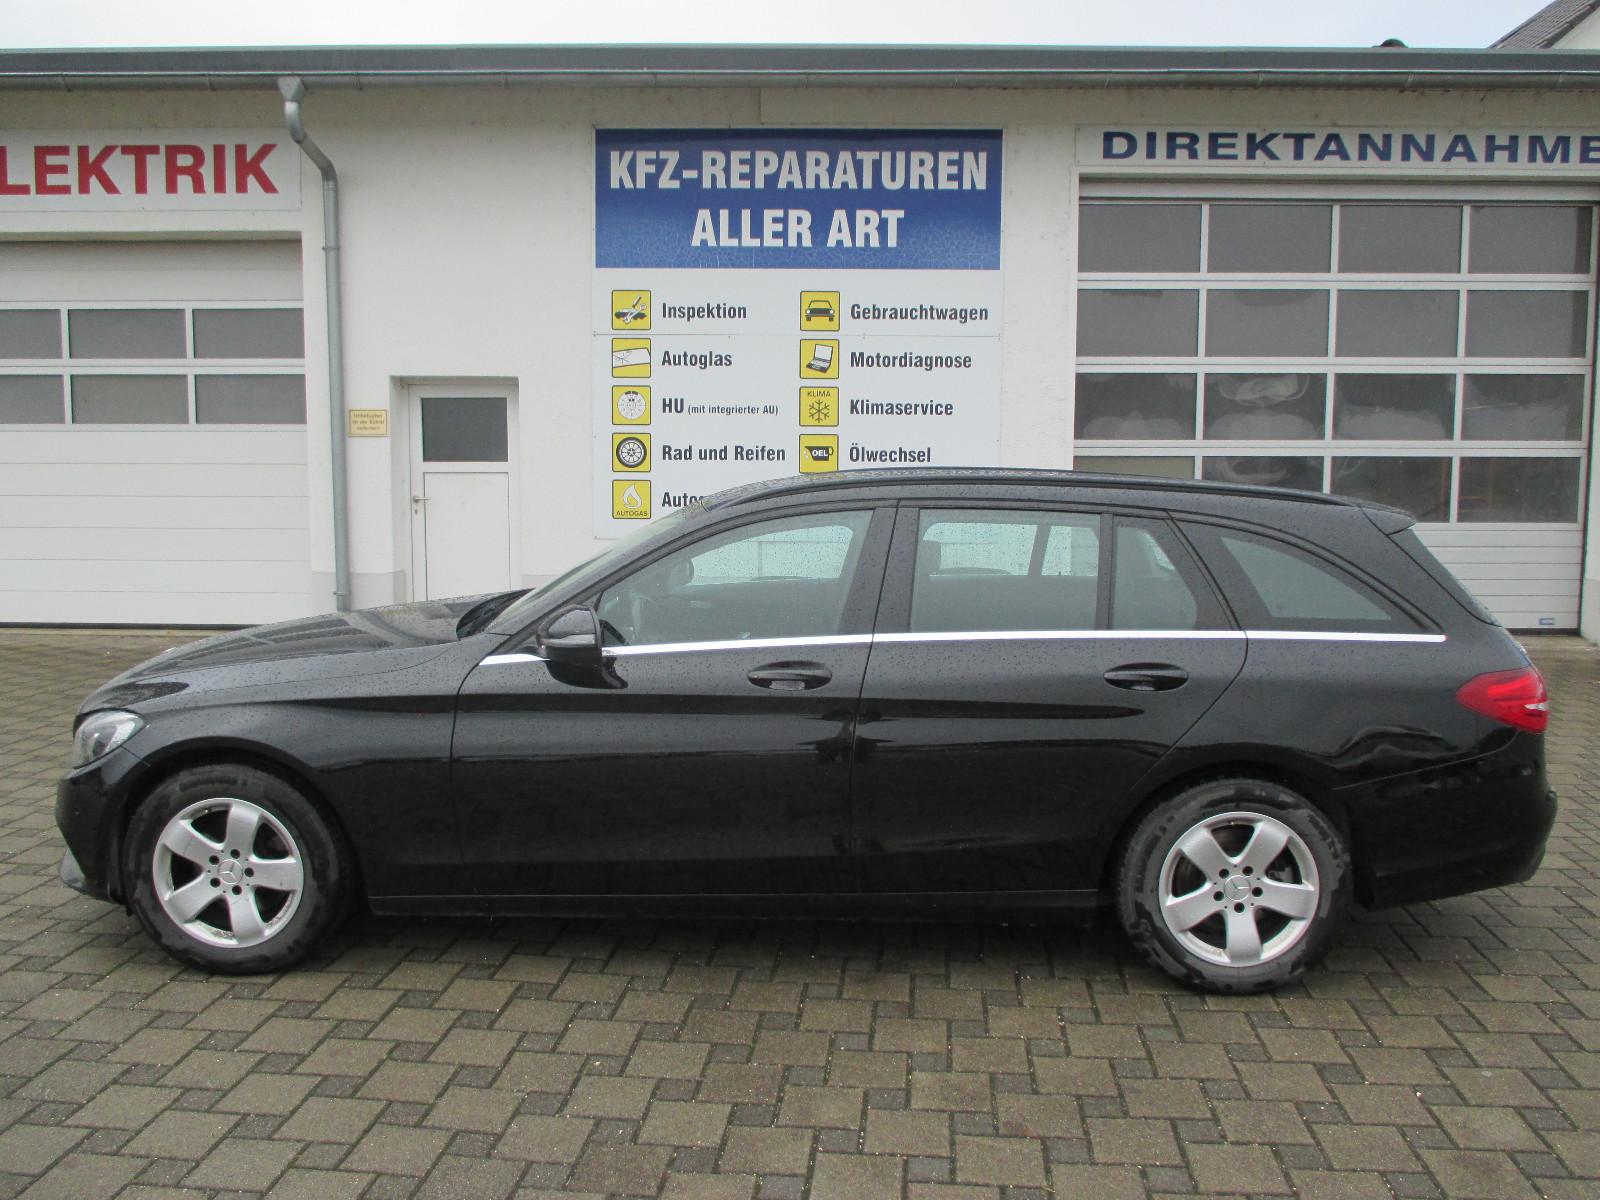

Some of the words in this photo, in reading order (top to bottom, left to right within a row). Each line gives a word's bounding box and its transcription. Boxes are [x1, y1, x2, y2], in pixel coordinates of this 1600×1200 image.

[1102, 131, 1600, 164] DIREKTANNAHME
[0, 143, 280, 195] LEKTRIK
[610, 150, 988, 191] KFZ-REPARATUREN
[690, 208, 813, 248] ALLER
[826, 208, 905, 248] ART
[662, 302, 747, 322] Inspektion
[850, 303, 989, 324] Gebrauchtwagen
[661, 350, 733, 370] Autoglas
[850, 351, 972, 371] Motordiagnose
[807, 390, 831, 398] KLIMA
[662, 397, 685, 414] HU
[688, 405, 706, 416] (mit
[708, 404, 760, 416] integrierter
[763, 405, 779, 416] AU)
[850, 399, 954, 416] Klimaservice
[662, 444, 693, 461] Rad
[699, 445, 728, 461] und
[734, 444, 786, 461] Reifen
[812, 449, 828, 457] OEL
[849, 442, 932, 463] Ölwechsel
